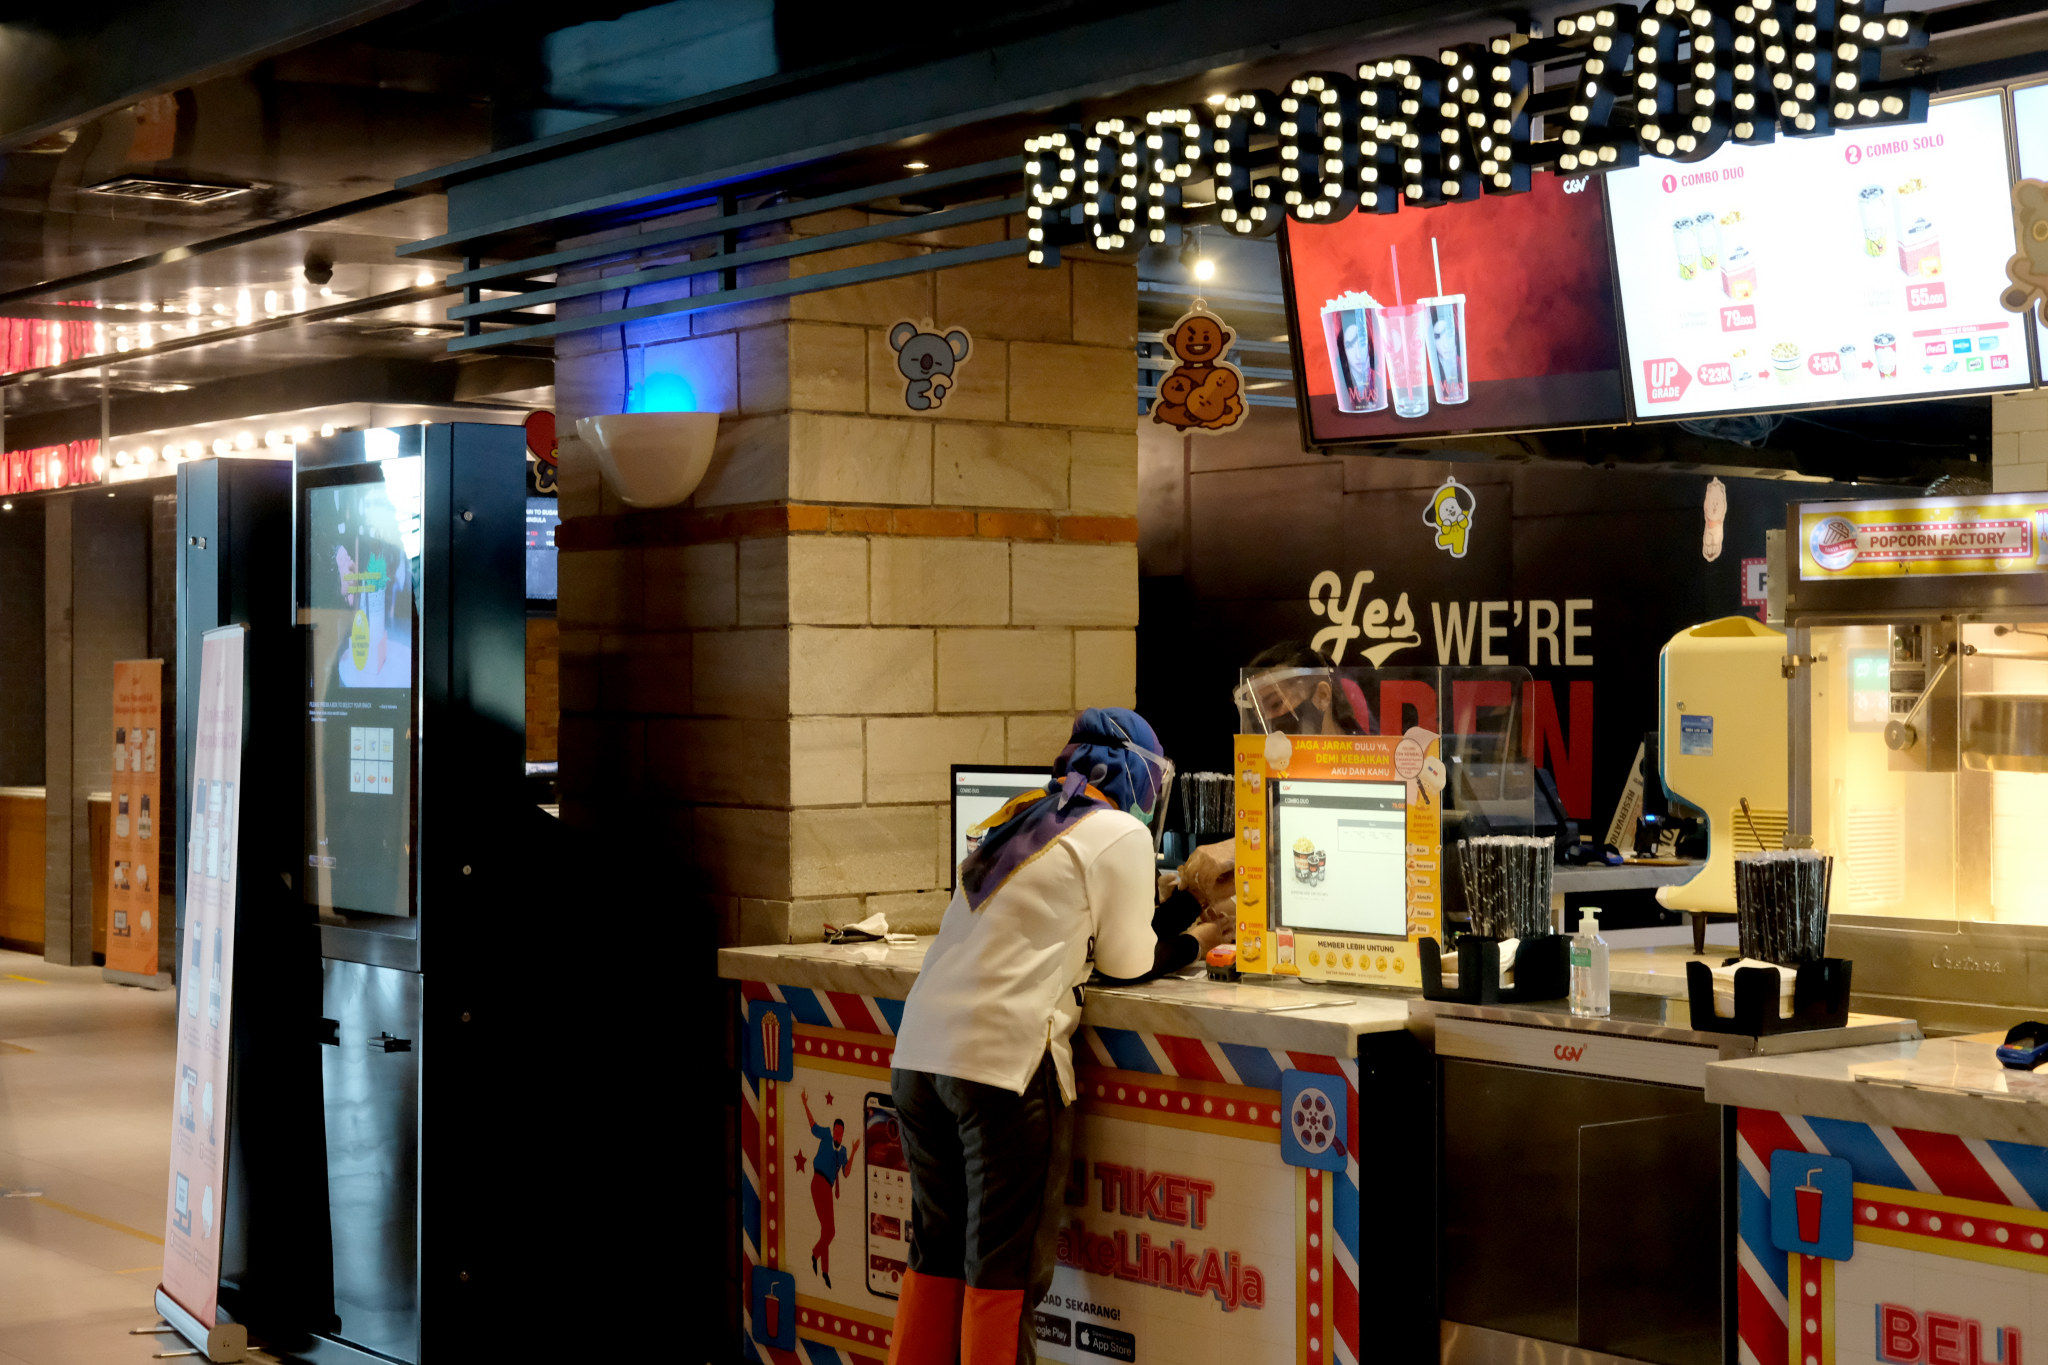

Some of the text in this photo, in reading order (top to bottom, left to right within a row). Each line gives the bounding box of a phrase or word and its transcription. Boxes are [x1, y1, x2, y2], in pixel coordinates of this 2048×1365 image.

[1023, 0, 1920, 267] POPCORN ZONE
[1846, 134, 1944, 164] 2 COMBO SOLO
[1563, 174, 1588, 194] CGV
[1681, 170, 1719, 187] COMBO
[1723, 166, 1744, 181] DUO
[1651, 362, 1679, 388] UP
[1652, 386, 1680, 399] GRADE
[1870, 534, 1937, 548] POPCORN
[1940, 531, 2006, 546] FACTORY
[1309, 570, 1593, 669] Yes WE'RE
[1295, 740, 1320, 750] JAGA
[1322, 741, 1352, 750] JARAK
[1354, 742, 1376, 751] DULU
[1316, 753, 1390, 765] DEMI KEBAIKAN
[1349, 768, 1366, 776] DAN
[1367, 768, 1390, 776] KAMU
[1609, 789, 1635, 845] RESERVATIO
[1318, 940, 1395, 953] MEMBER LEBIH UNTUNG
[1554, 1044, 1584, 1062] CGV
[1094, 1162, 1215, 1230] TIKET
[1056, 1219, 1265, 1312] akeLinkAja
[1065, 1298, 1121, 1321] SEKARANG!
[1092, 1338, 1132, 1357] App Store
